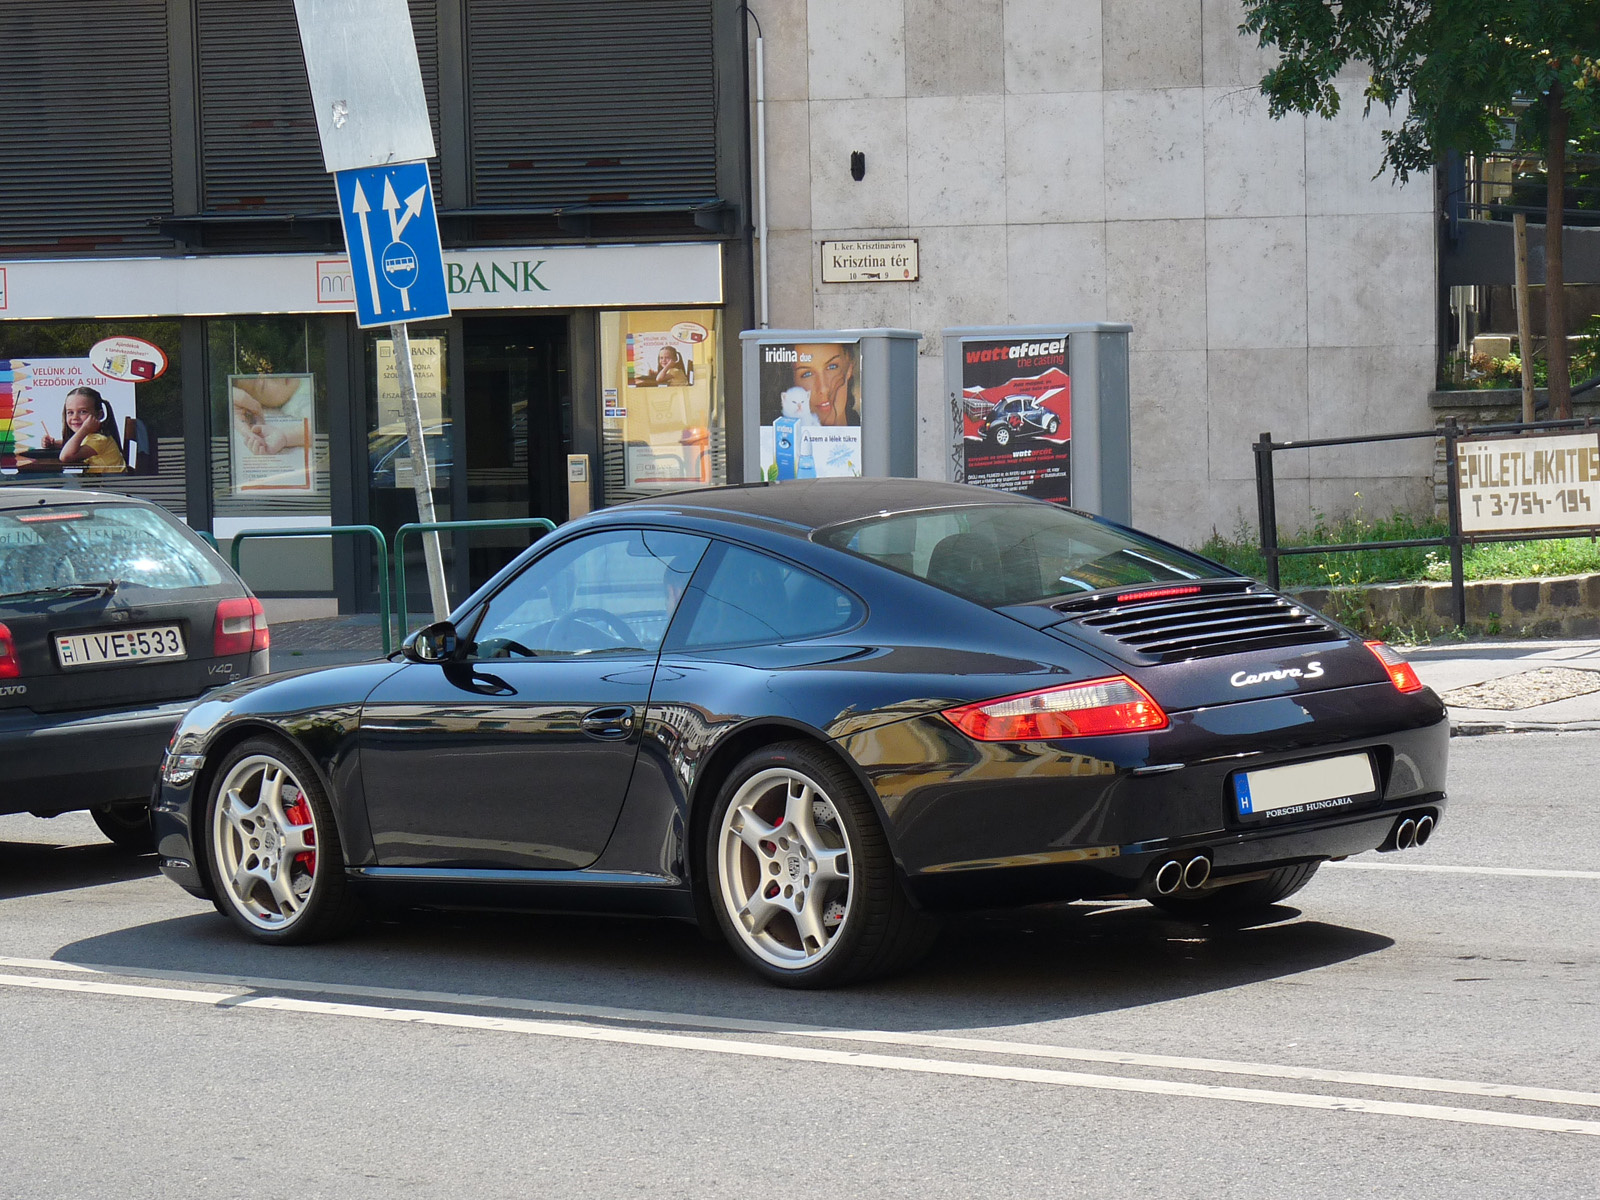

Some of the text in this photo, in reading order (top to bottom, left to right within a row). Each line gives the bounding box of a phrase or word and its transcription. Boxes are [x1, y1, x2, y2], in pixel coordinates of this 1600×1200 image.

[857, 242, 906, 250] Krisztinaváros
[833, 254, 909, 268] Krisztina tér
[445, 261, 551, 294] BANK
[411, 347, 436, 355] BANK
[765, 347, 812, 362] iridina due
[966, 339, 1066, 364] wattaface!
[1017, 355, 1064, 368] the casting
[33, 366, 82, 376] VELÜNK JÓL
[86, 378, 107, 386] SULI!
[1472, 494, 1482, 517] T
[63, 651, 74, 663] H
[208, 663, 233, 675] V40
[1231, 661, 1325, 687] Carrera S
[1241, 797, 1249, 809] H
[1266, 797, 1352, 818] PORSCHE HUNGARIA
